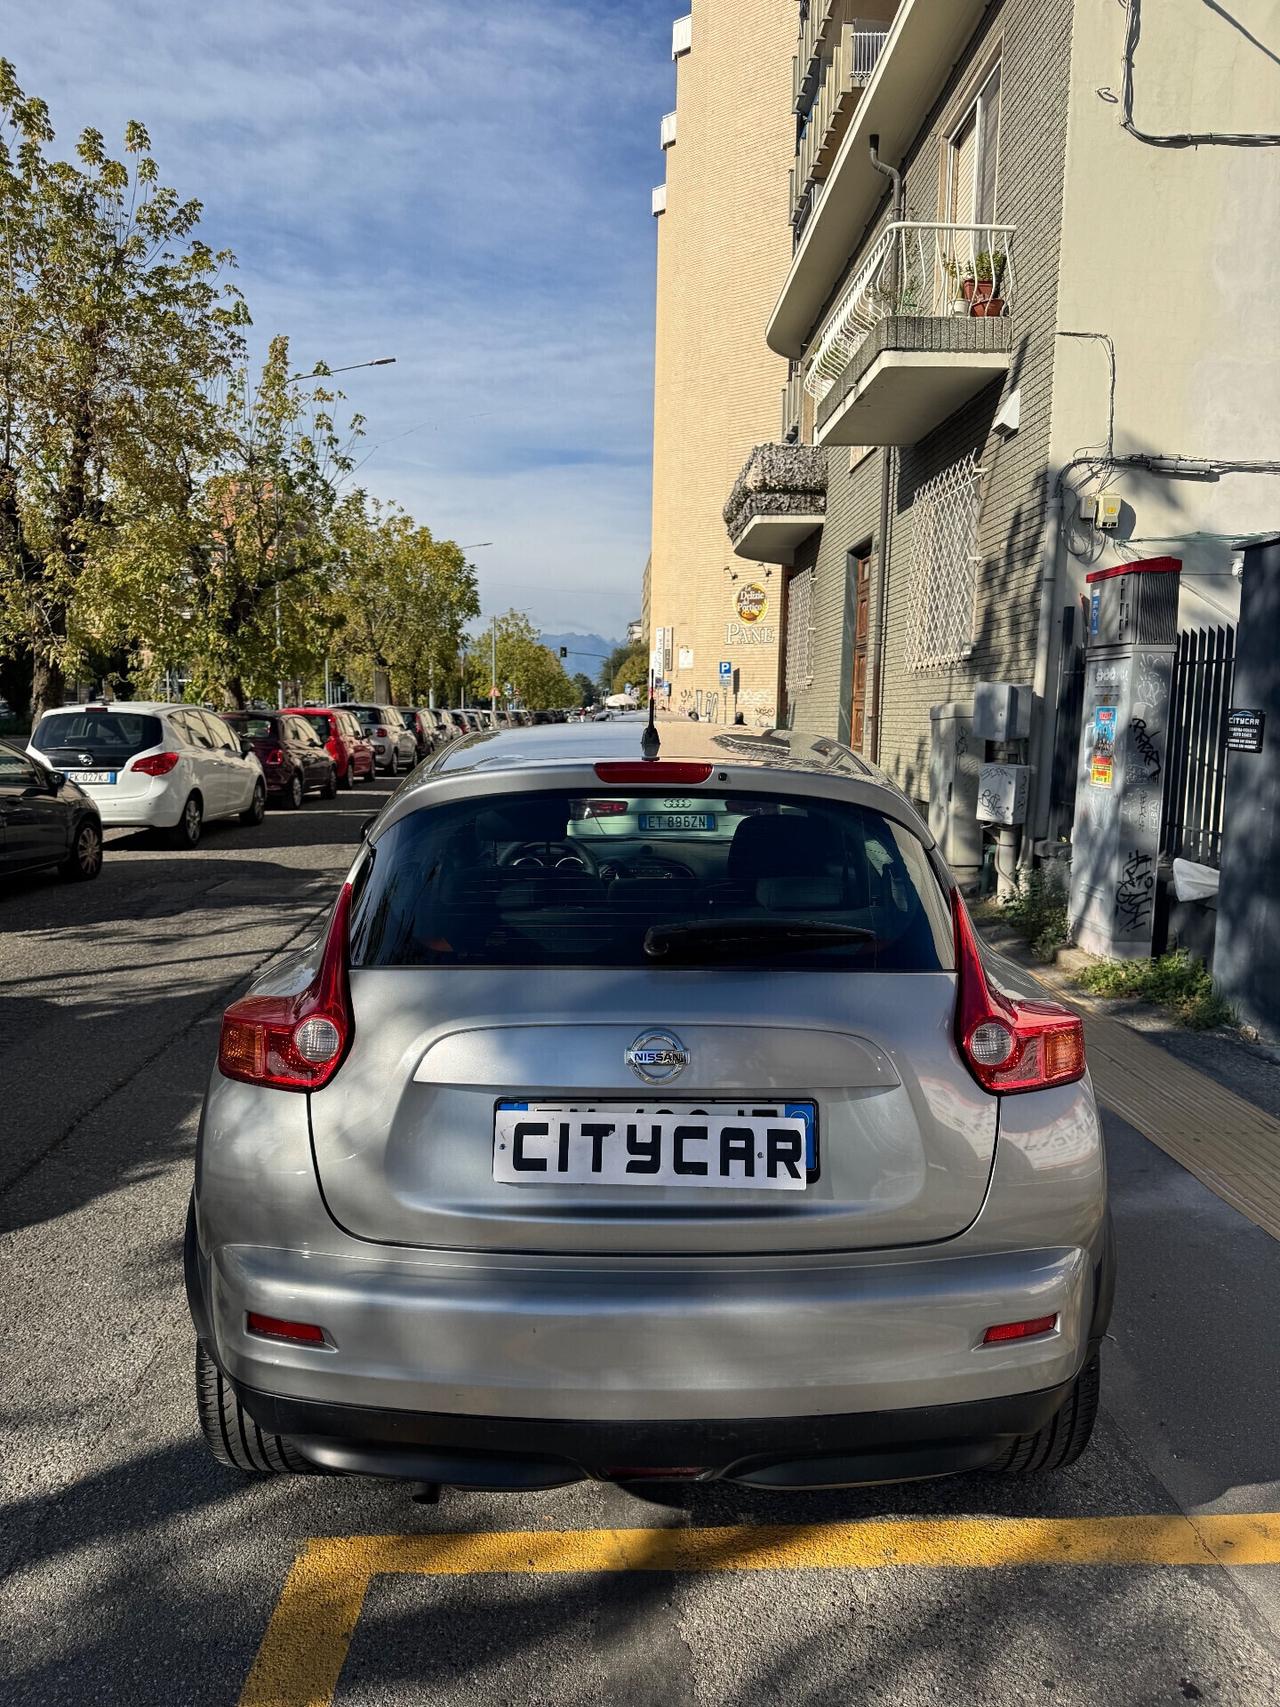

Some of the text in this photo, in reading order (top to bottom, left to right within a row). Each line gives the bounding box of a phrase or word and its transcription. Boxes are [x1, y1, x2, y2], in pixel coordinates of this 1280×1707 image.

[741, 590, 765, 600] Delizie
[737, 602, 763, 612] Portico
[724, 623, 775, 645] PANE
[721, 662, 730, 673] P
[1228, 717, 1260, 726] CITYCAR
[634, 1053, 682, 1062] NISSAN
[512, 1122, 802, 1179] CITYCAR
